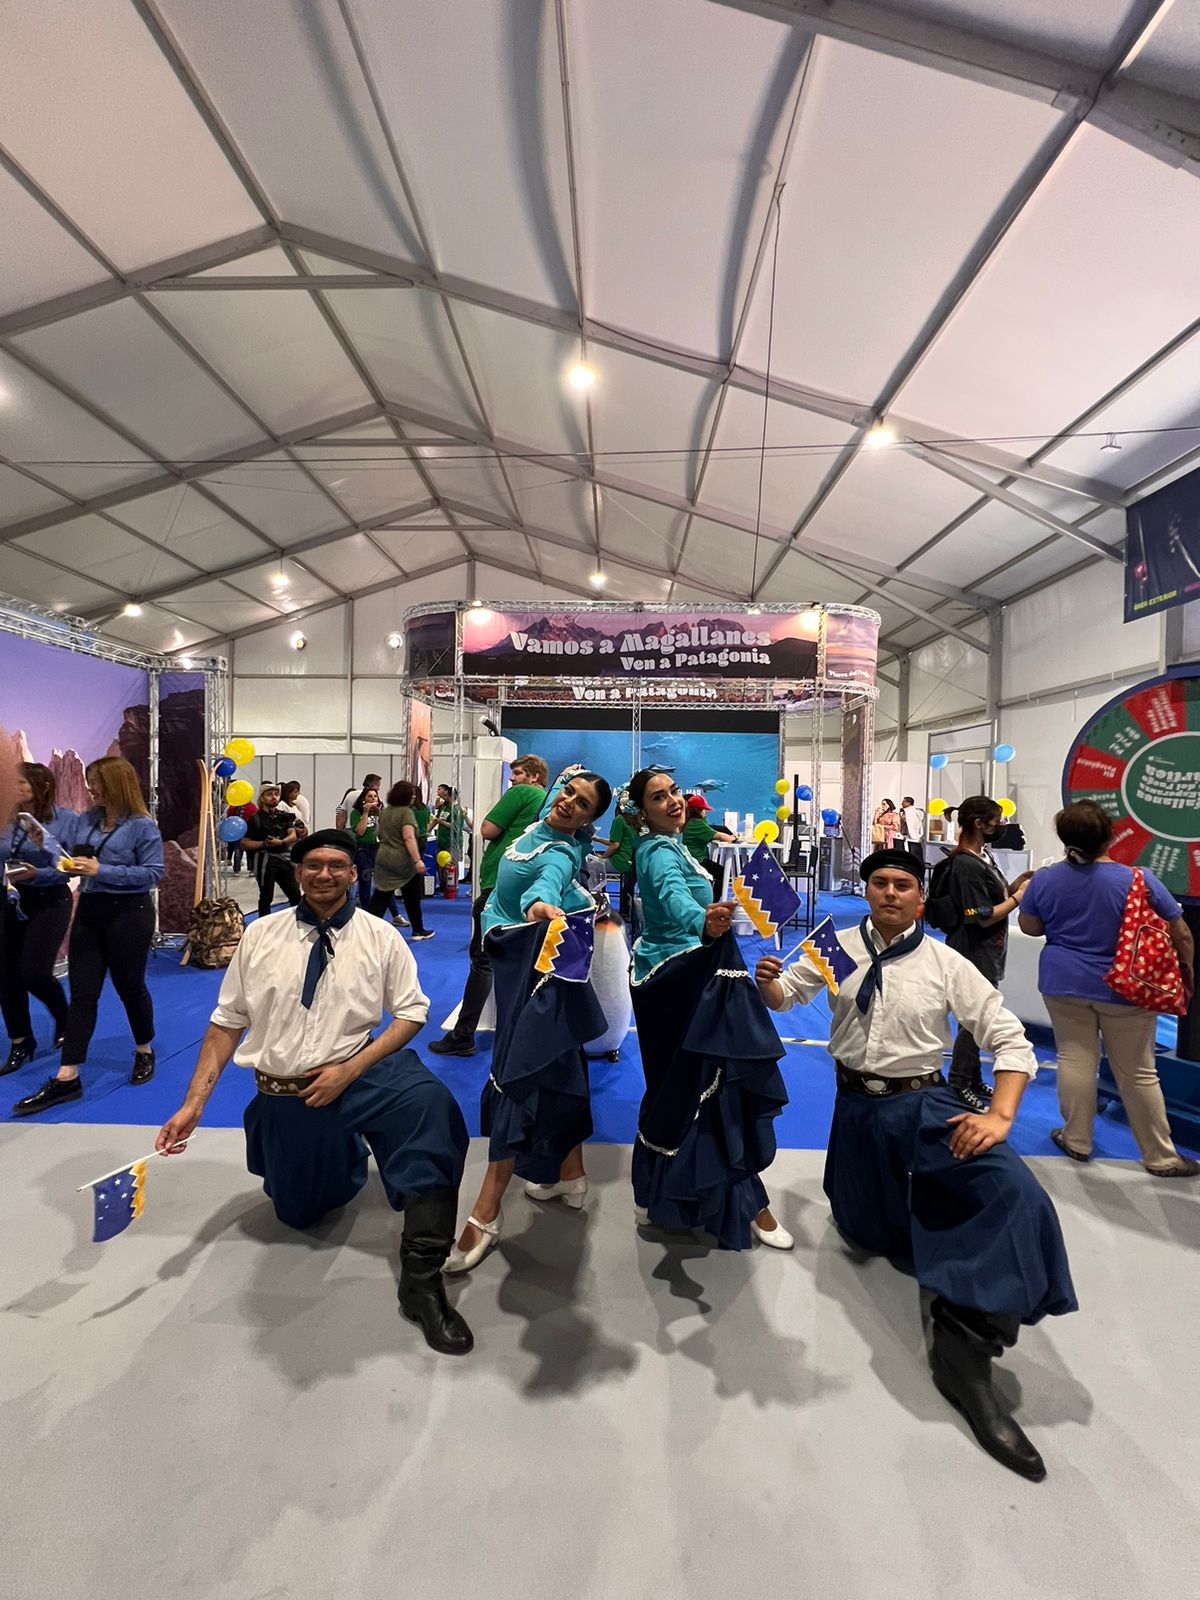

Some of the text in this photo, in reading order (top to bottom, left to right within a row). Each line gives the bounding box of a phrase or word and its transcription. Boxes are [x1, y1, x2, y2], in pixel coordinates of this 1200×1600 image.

[509, 626, 771, 655] Vamos a Magallanes
[620, 648, 771, 671] Ven a Patagonia
[572, 686, 606, 700] Ven
[610, 688, 621, 699] a
[625, 679, 717, 700] Patagonia
